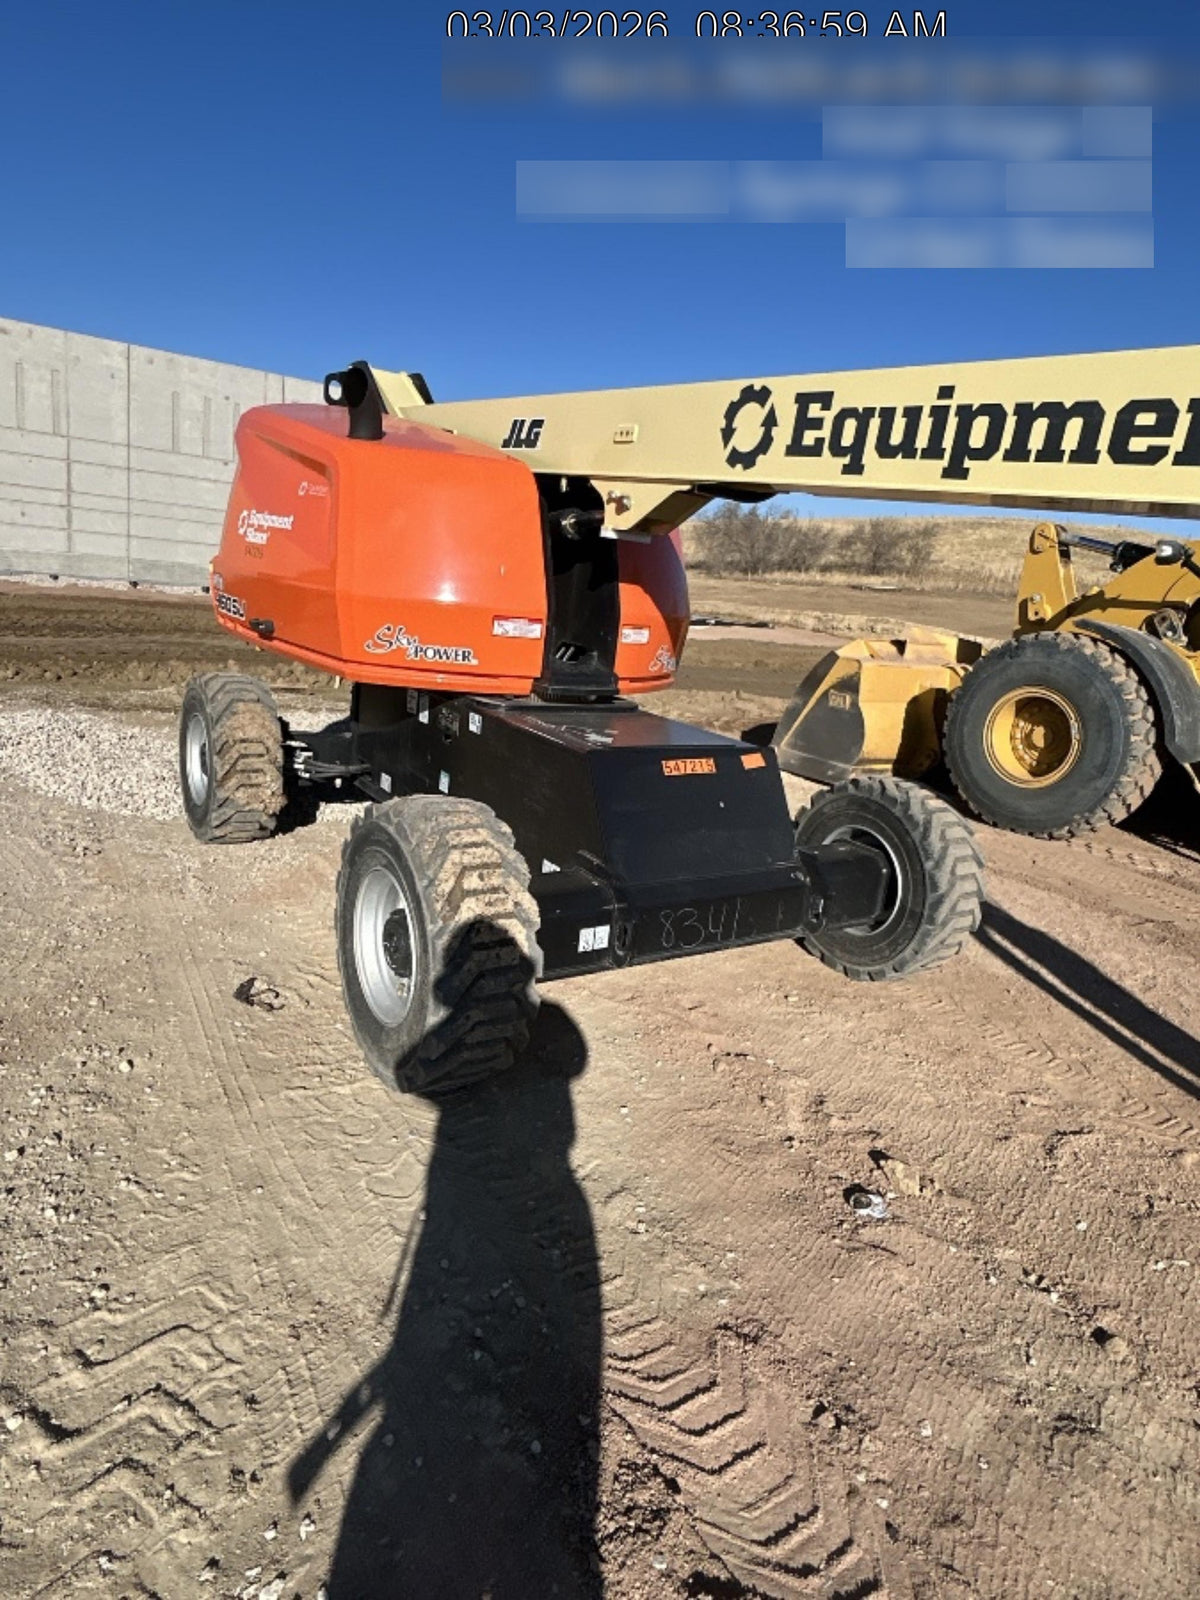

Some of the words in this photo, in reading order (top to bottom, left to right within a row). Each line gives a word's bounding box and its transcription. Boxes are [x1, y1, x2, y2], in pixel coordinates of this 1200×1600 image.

[502, 417, 545, 450] JLG
[364, 624, 418, 658] Sky
[413, 645, 476, 665] POWER
